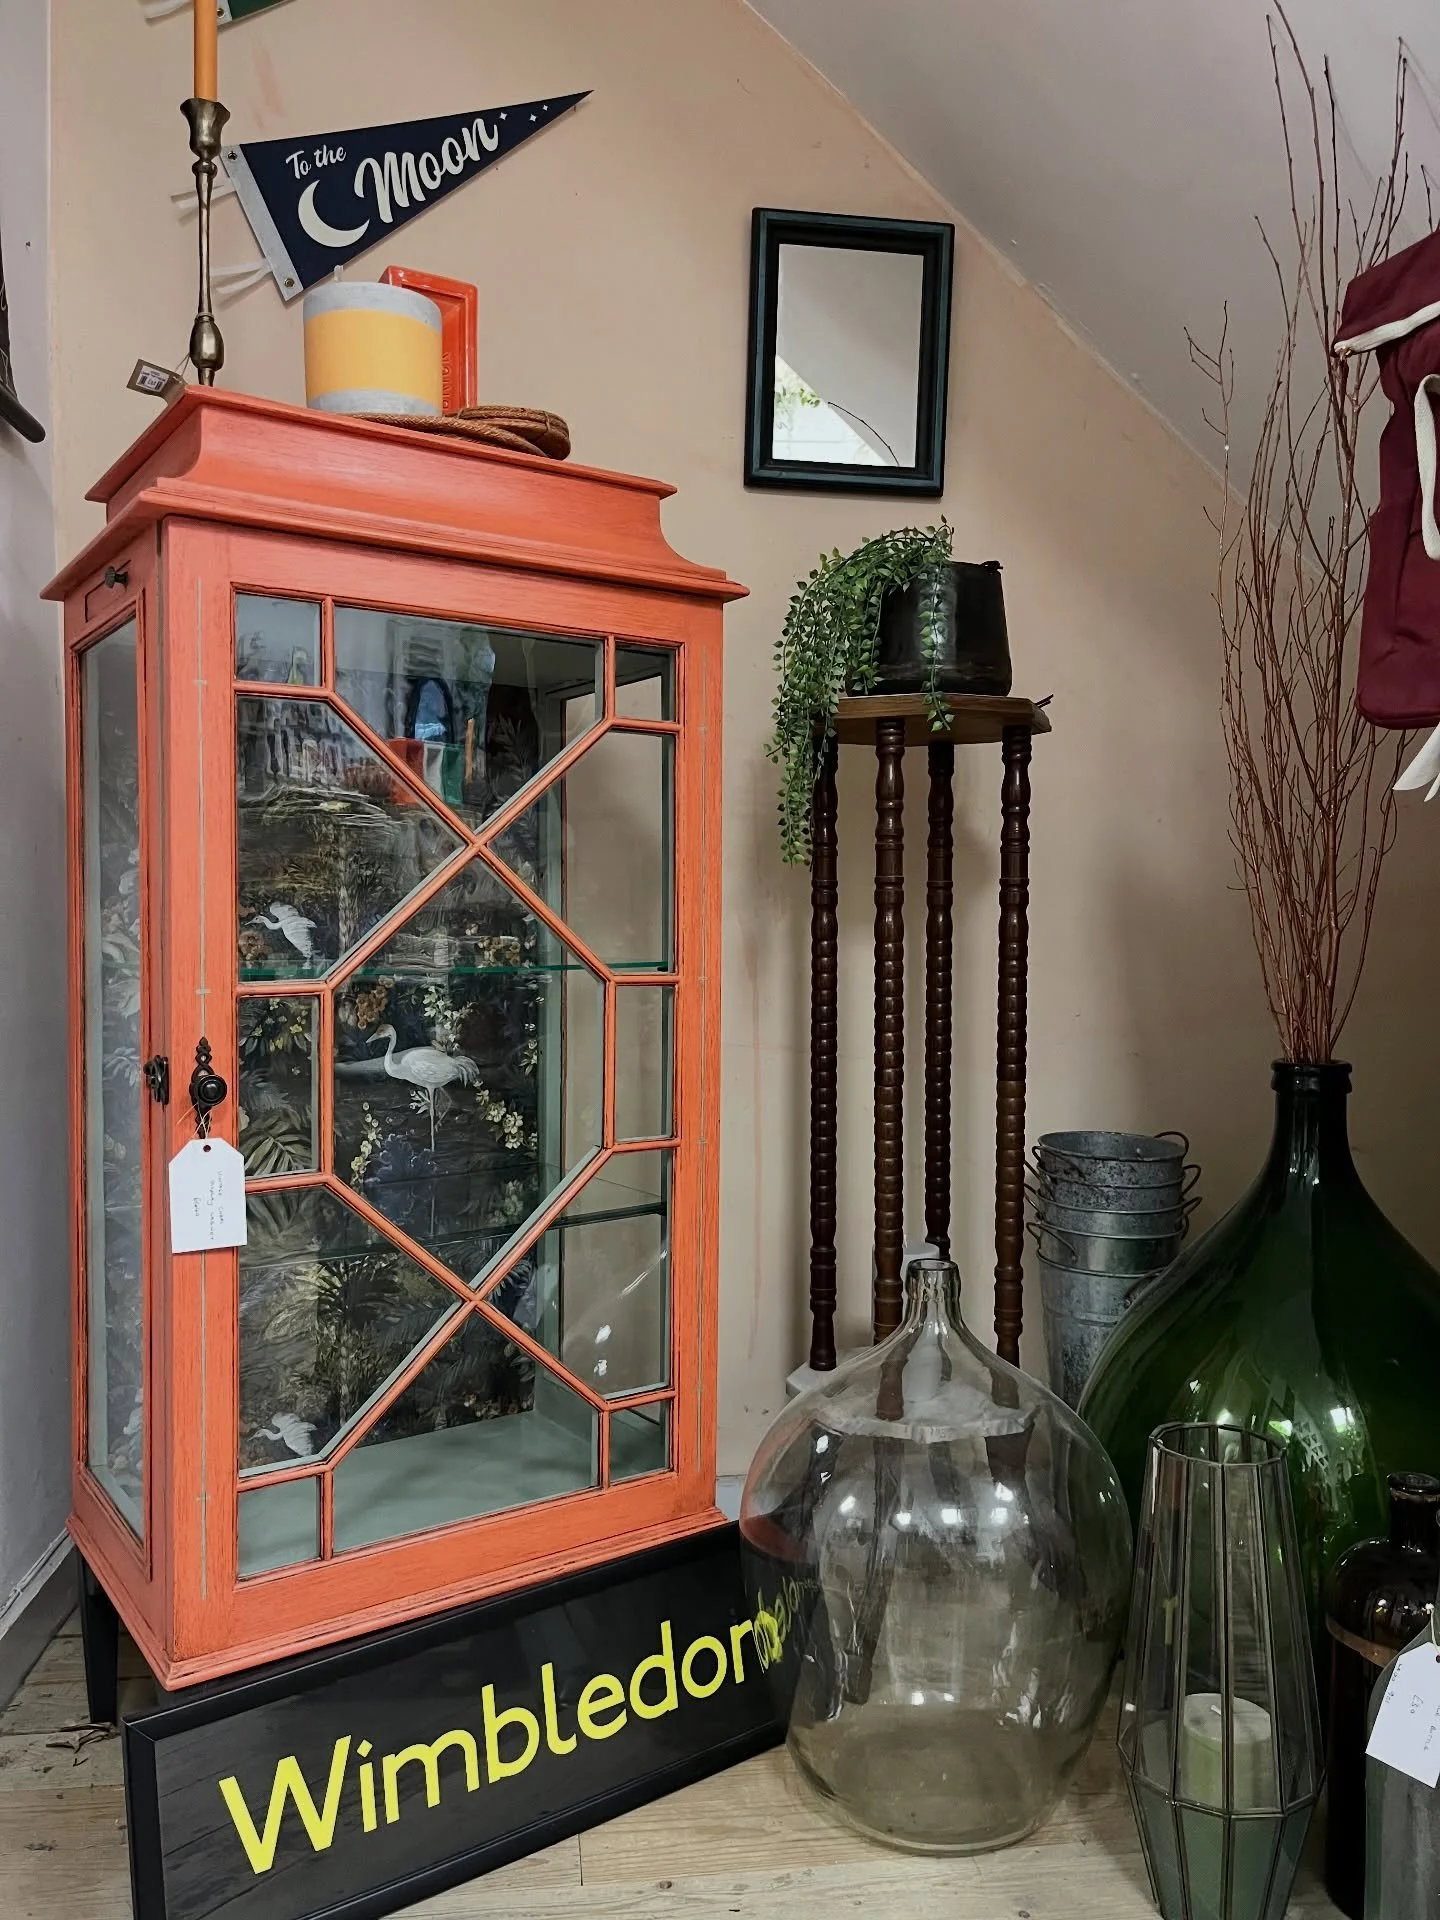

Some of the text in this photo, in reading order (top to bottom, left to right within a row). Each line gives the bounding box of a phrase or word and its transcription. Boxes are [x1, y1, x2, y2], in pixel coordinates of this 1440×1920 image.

[286, 144, 347, 180] To the
[354, 118, 499, 224] Moon
[219, 1619, 770, 1875] Wimbledon
